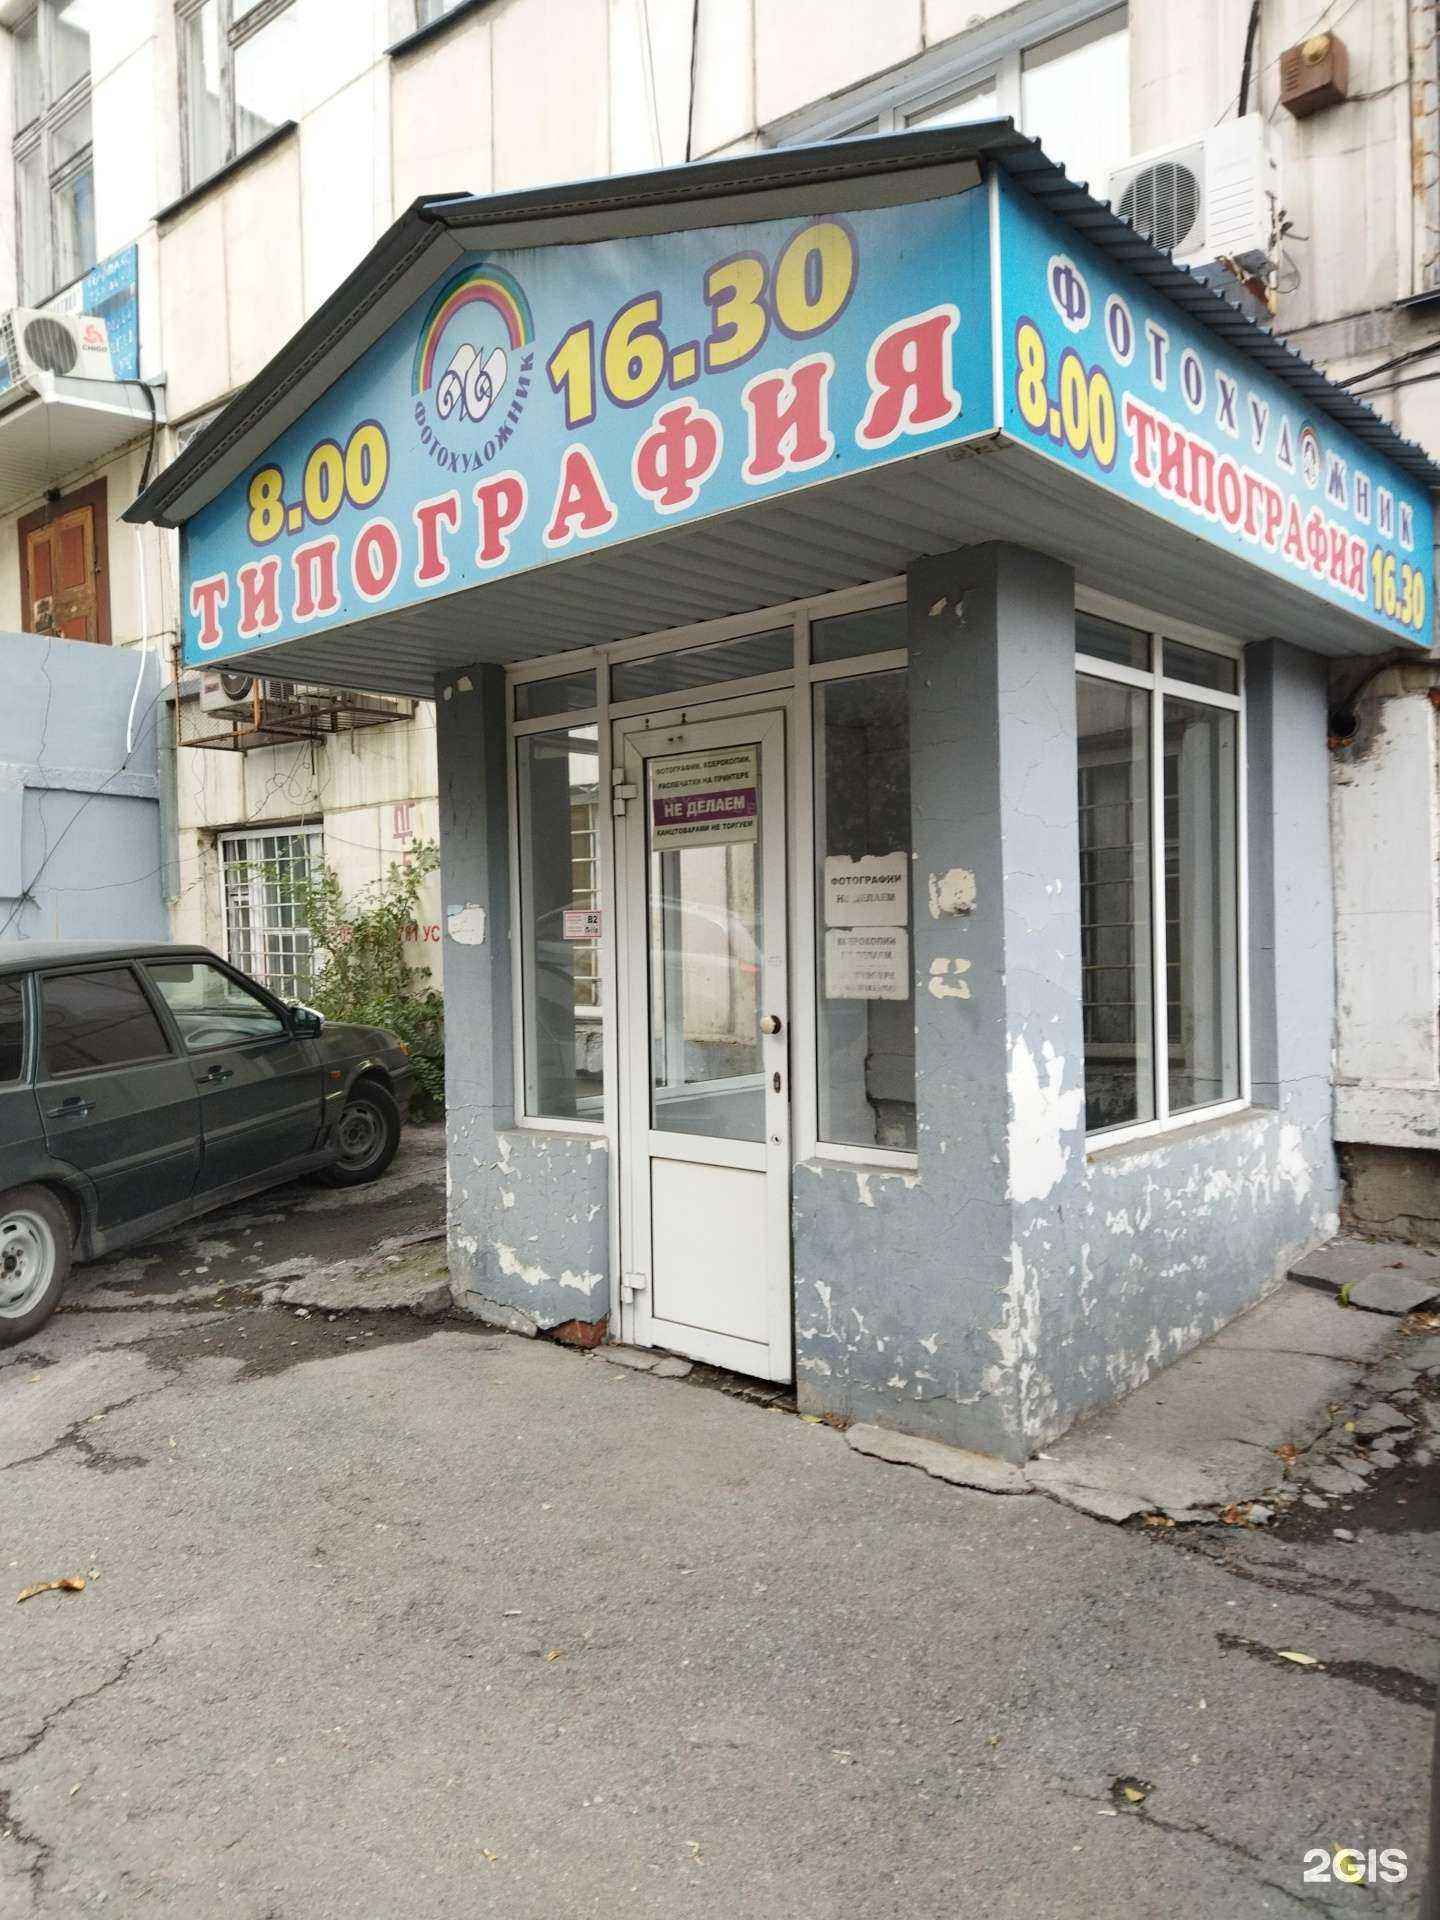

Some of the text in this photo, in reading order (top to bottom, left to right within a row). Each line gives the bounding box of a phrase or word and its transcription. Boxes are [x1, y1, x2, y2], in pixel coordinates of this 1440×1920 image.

[547, 213, 859, 430] 16.30
[413, 351, 535, 474] ФОТОХУДОЖНИК
[1015, 315, 1118, 473] 8.00
[191, 304, 959, 650] ТИПОГРАФИЯ
[247, 418, 390, 546] 8.00
[1123, 390, 1369, 601] ТИПОГРАФИЯ
[1370, 545, 1426, 631] 16.30
[664, 795, 746, 818] НЕ ДЕЛАЕМ
[830, 874, 902, 886] ФОТОГРАФИИ
